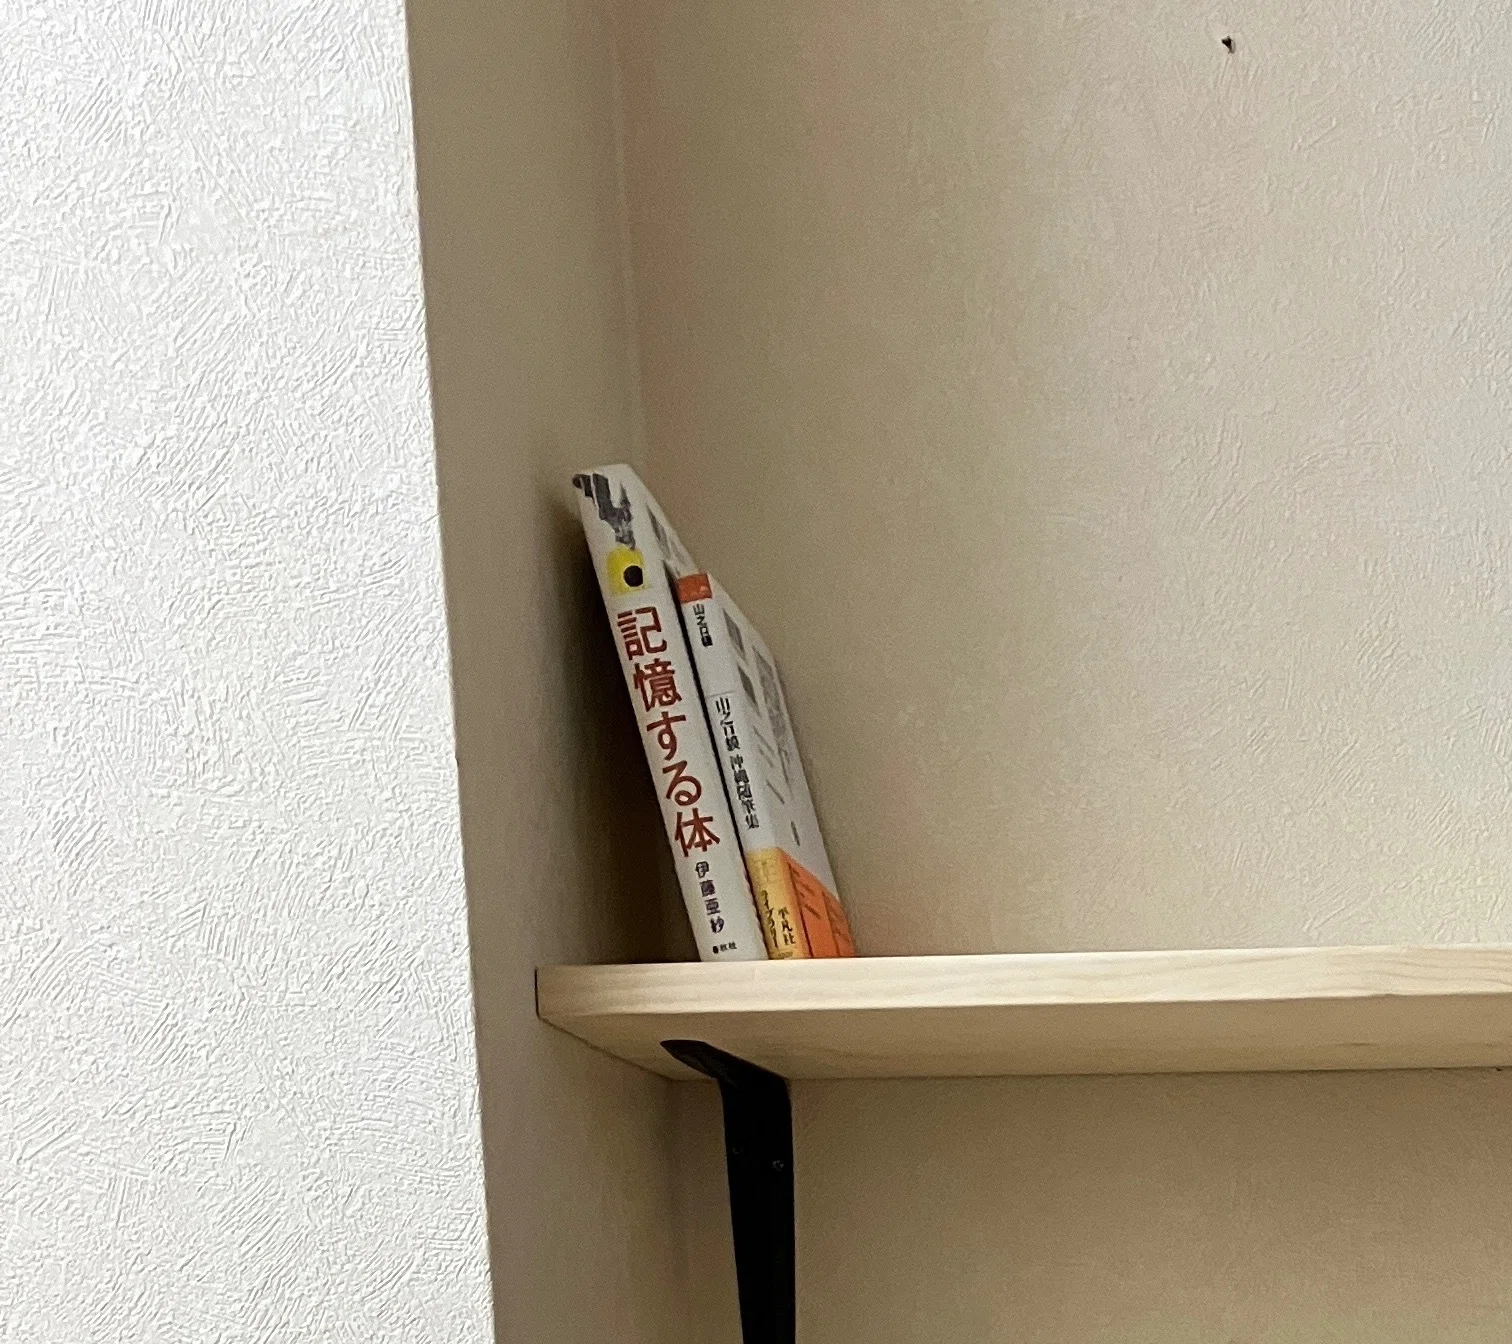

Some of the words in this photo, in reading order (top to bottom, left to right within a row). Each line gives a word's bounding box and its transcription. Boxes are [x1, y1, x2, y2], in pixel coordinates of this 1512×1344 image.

[617, 605, 721, 858] 記憶する体
